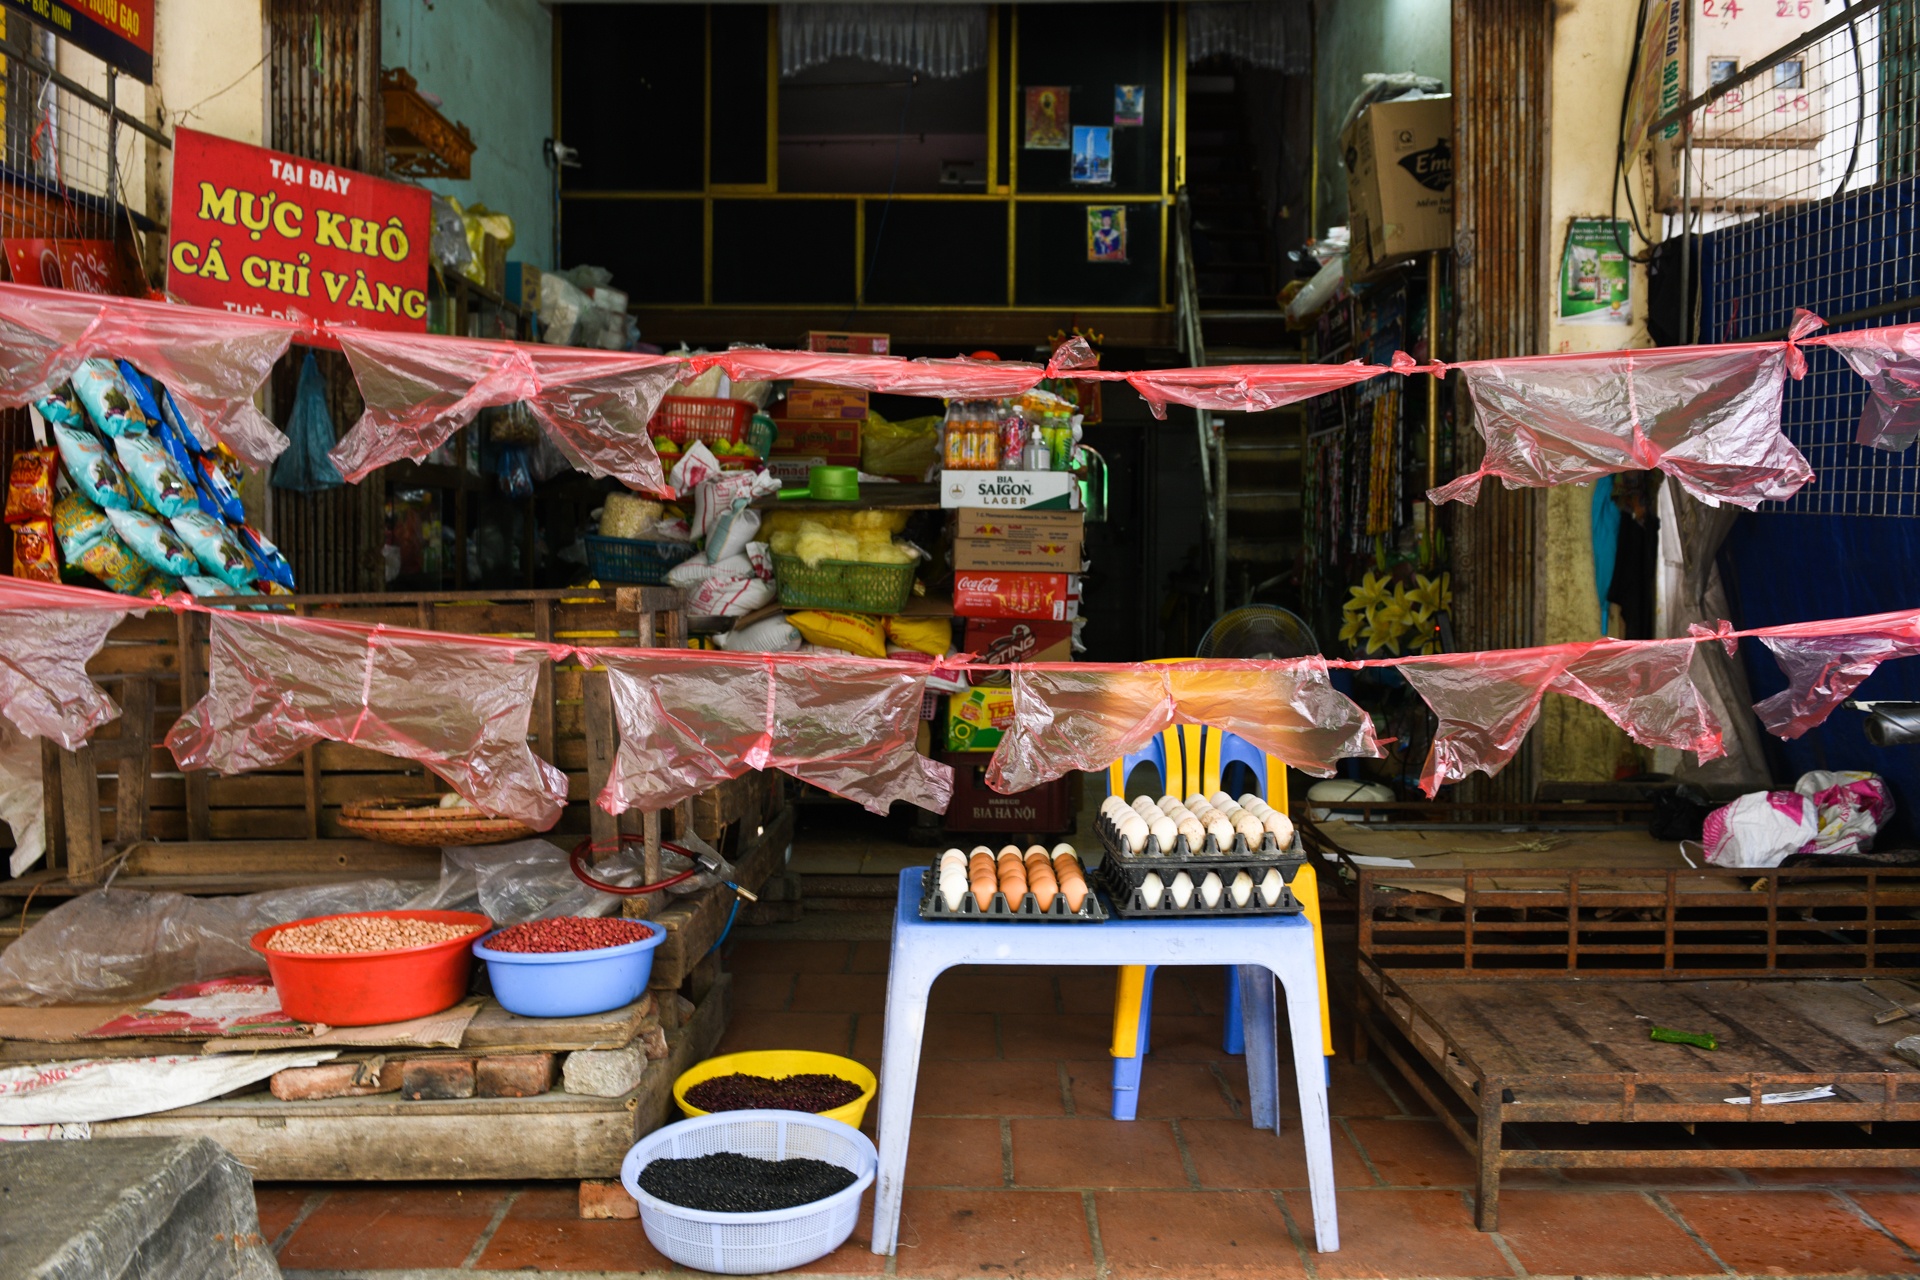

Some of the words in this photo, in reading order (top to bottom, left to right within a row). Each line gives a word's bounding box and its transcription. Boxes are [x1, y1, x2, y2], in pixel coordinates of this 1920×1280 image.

[51, 3, 72, 31] NINH
[120, 4, 140, 38] GẠO
[269, 158, 303, 186] TẠI
[309, 170, 351, 195] ĐÂY
[197, 181, 304, 241] MỰC
[314, 209, 410, 262] KHÔ
[171, 238, 231, 282] CÁ
[240, 252, 312, 298] CHỈ
[320, 269, 428, 320] VÀNG
[978, 484, 1031, 495] SAIGON
[988, 634, 1036, 665] STING
[973, 807, 992, 819] BIA
[995, 806, 1011, 819] HÀ
[1014, 805, 1036, 820] NỘI
